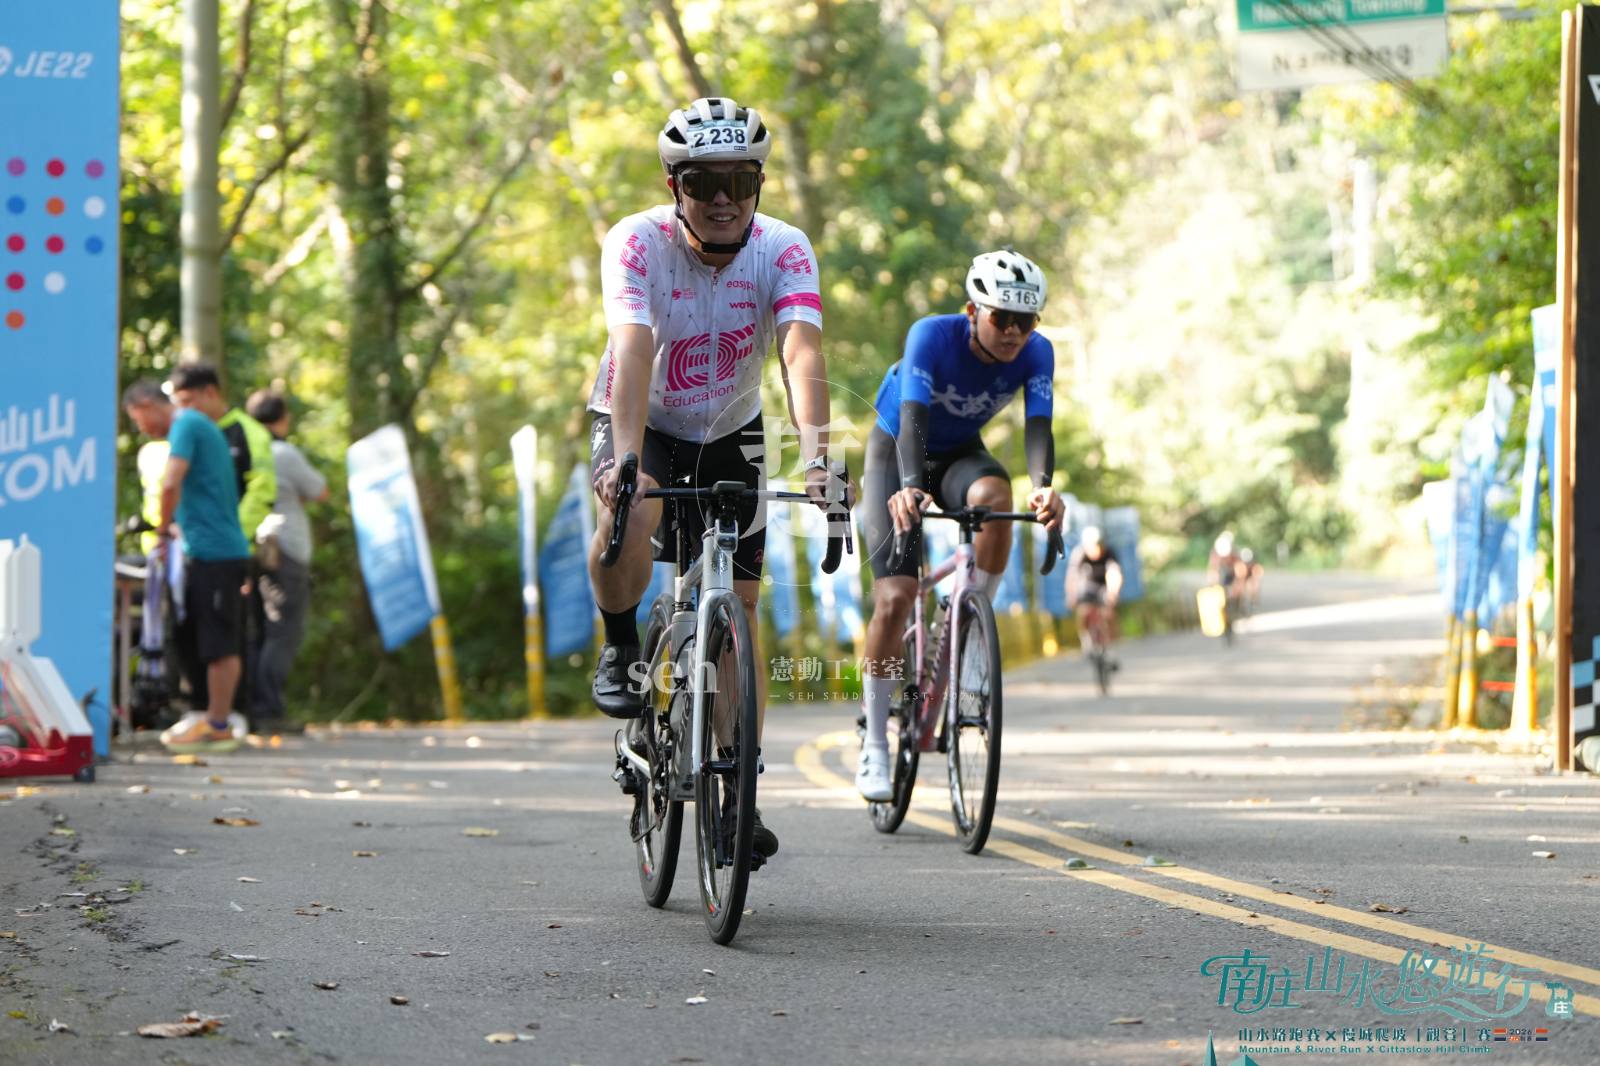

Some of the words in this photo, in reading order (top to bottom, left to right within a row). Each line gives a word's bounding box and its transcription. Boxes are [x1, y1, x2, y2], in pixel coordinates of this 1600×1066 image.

[14, 50, 93, 78] JE22
[691, 127, 746, 148] 2238
[1002, 290, 1038, 306] 5163
[663, 384, 734, 408] Education
[0, 436, 97, 506] OM
